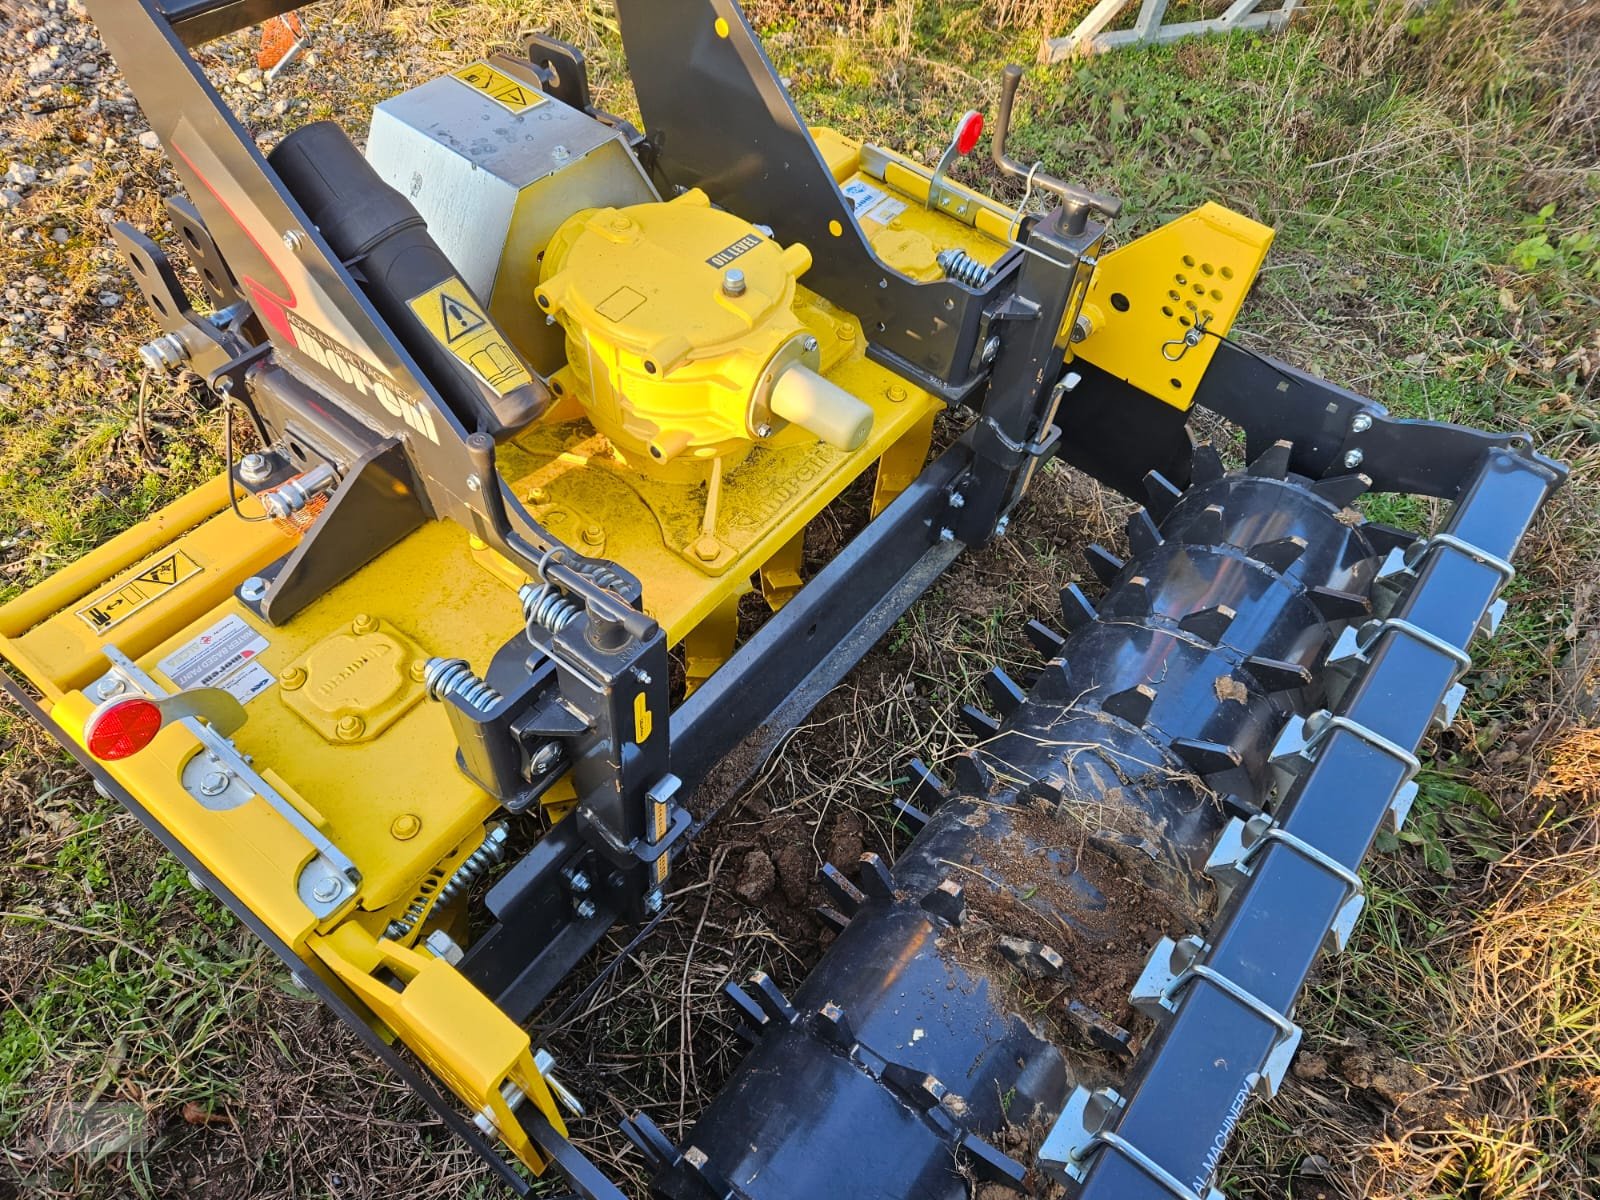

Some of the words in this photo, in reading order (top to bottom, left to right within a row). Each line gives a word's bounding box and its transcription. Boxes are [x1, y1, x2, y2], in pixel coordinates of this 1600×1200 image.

[711, 253, 734, 266] OIL
[727, 237, 760, 257] LEVEL
[286, 311, 359, 368] AGRICULTURAL
[358, 359, 417, 407] MACHINERY
[226, 629, 254, 650] WATER
[200, 646, 229, 668] BASED
[178, 664, 203, 685] PAINT
[1201, 1081, 1252, 1174] MACHINERY
